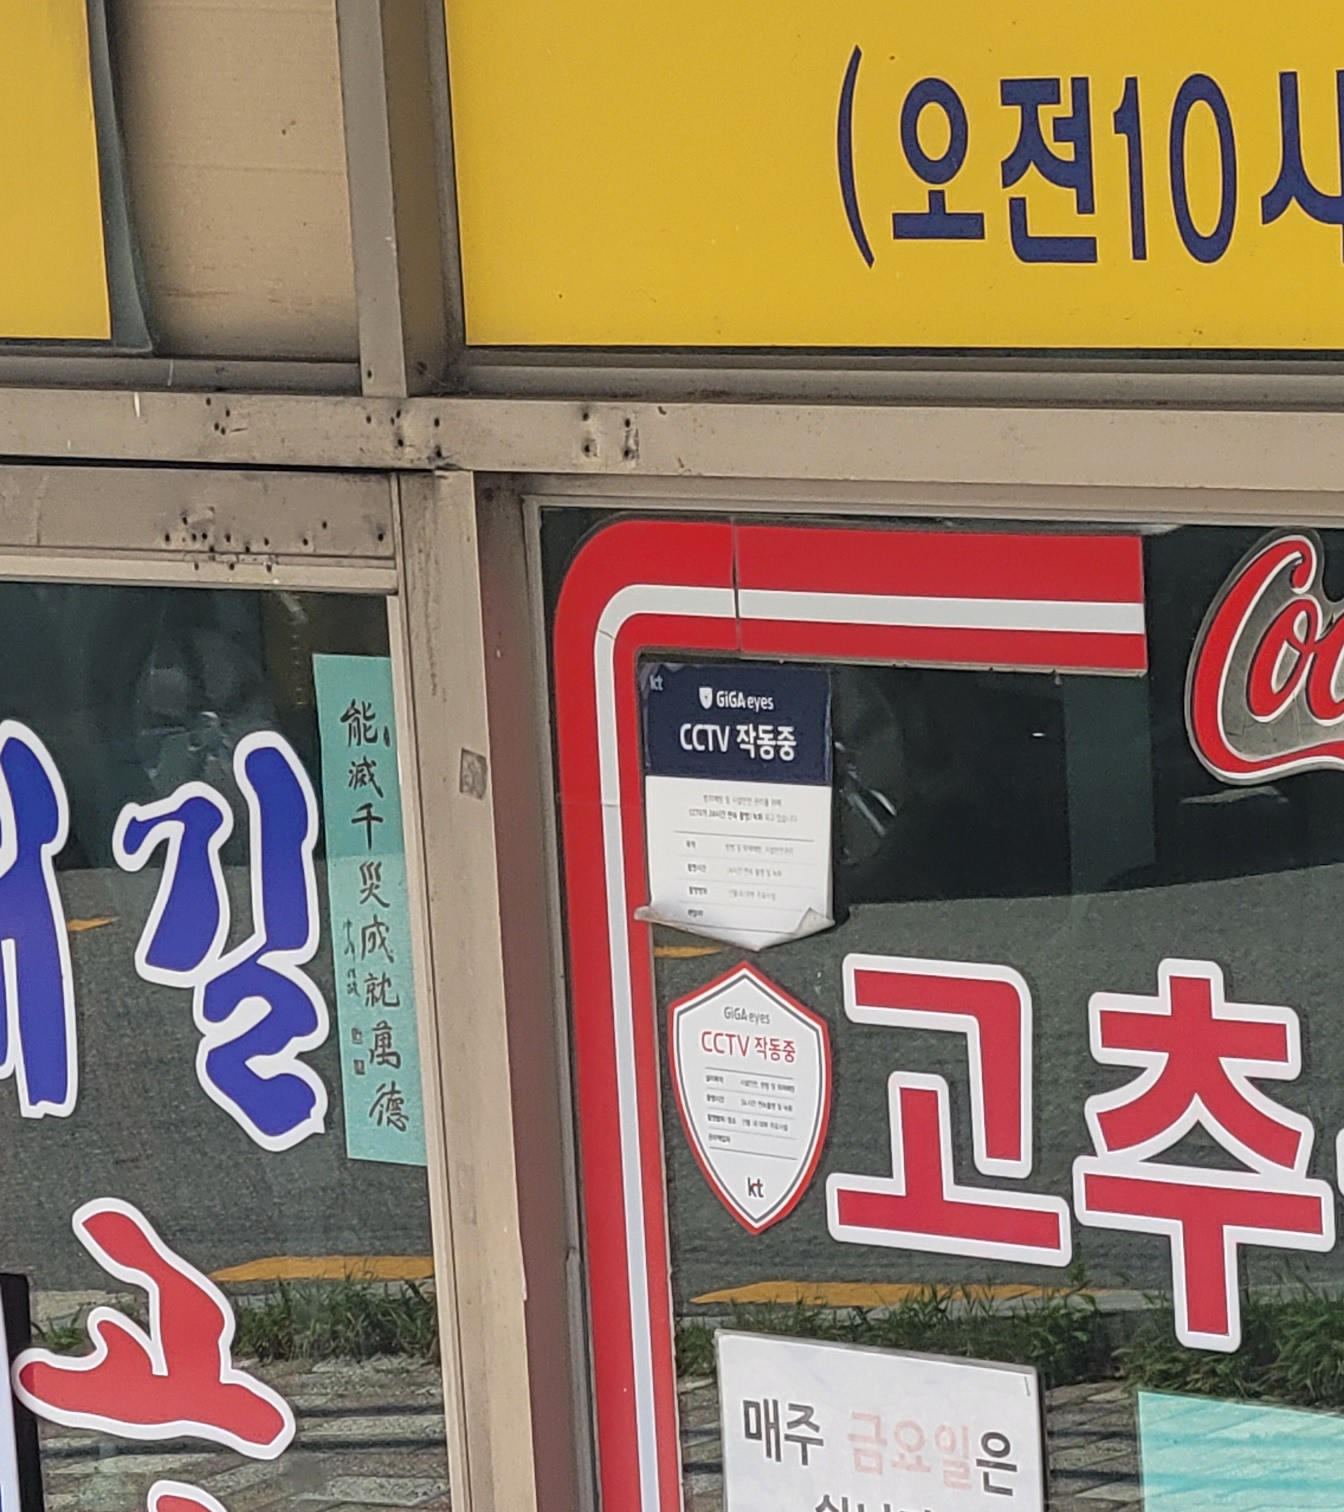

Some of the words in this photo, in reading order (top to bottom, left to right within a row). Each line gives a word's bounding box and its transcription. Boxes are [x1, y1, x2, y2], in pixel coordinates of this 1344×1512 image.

[680, 723, 730, 752] CCTV
[736, 724, 797, 761] 작동중
[701, 1031, 750, 1056] CCTV
[754, 1036, 796, 1063] 작동중
[747, 1177, 764, 1198] kt
[742, 1398, 824, 1466] 매주
[847, 1410, 1018, 1496] 금요일은
